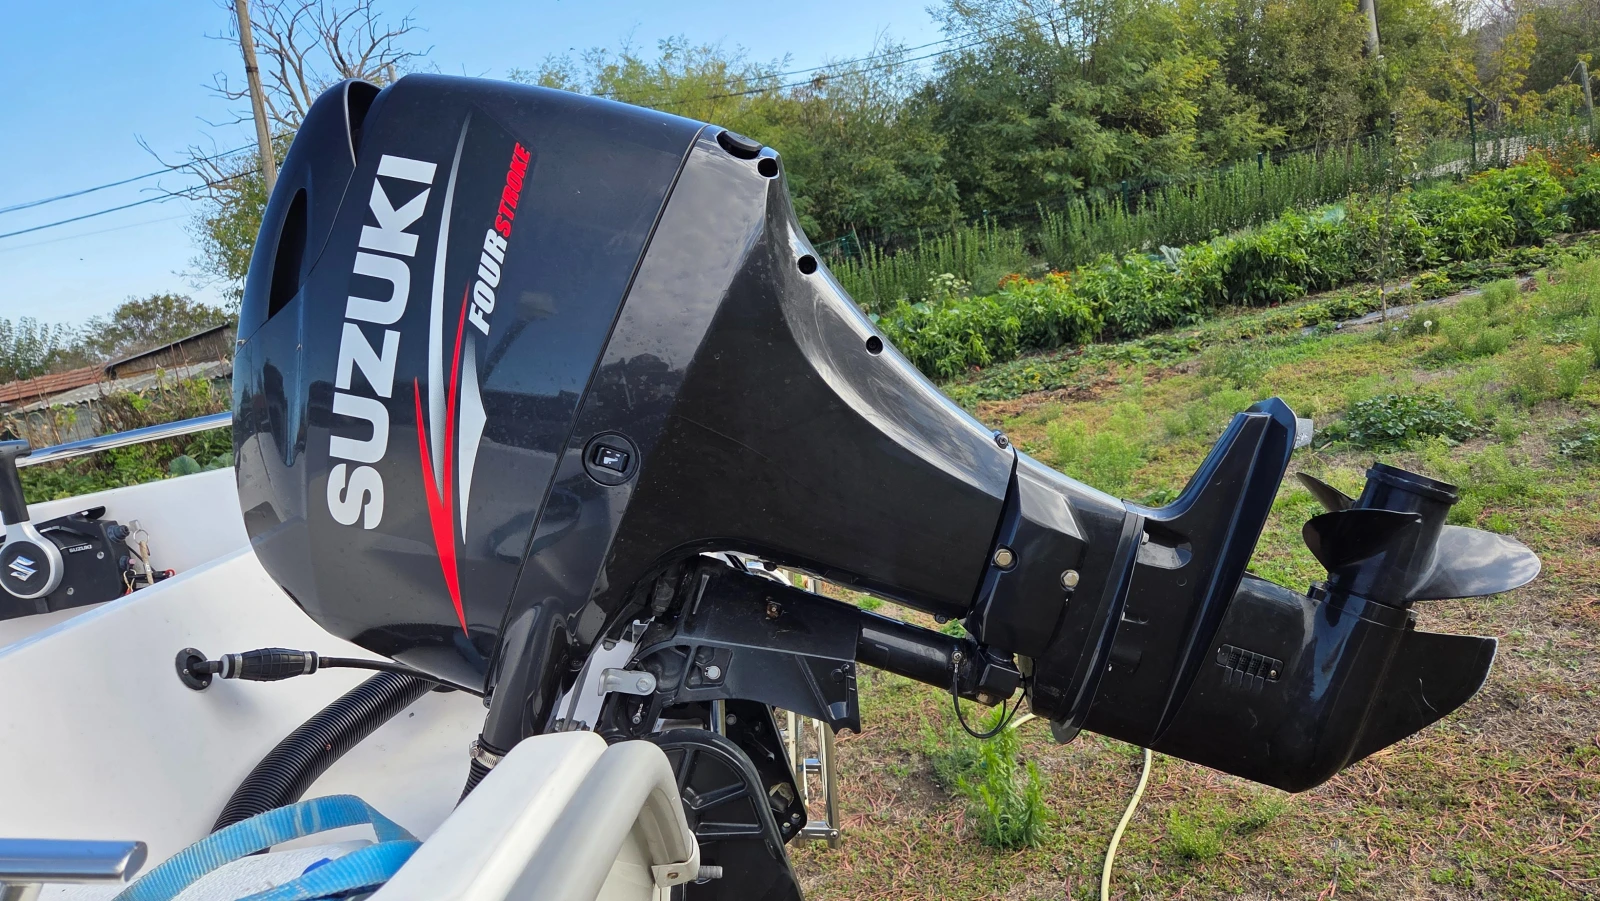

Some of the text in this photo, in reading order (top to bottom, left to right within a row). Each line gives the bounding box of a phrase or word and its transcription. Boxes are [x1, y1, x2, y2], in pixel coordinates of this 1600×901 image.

[327, 154, 438, 530] SUZUKI
[468, 141, 531, 336] FOUR STROKE
